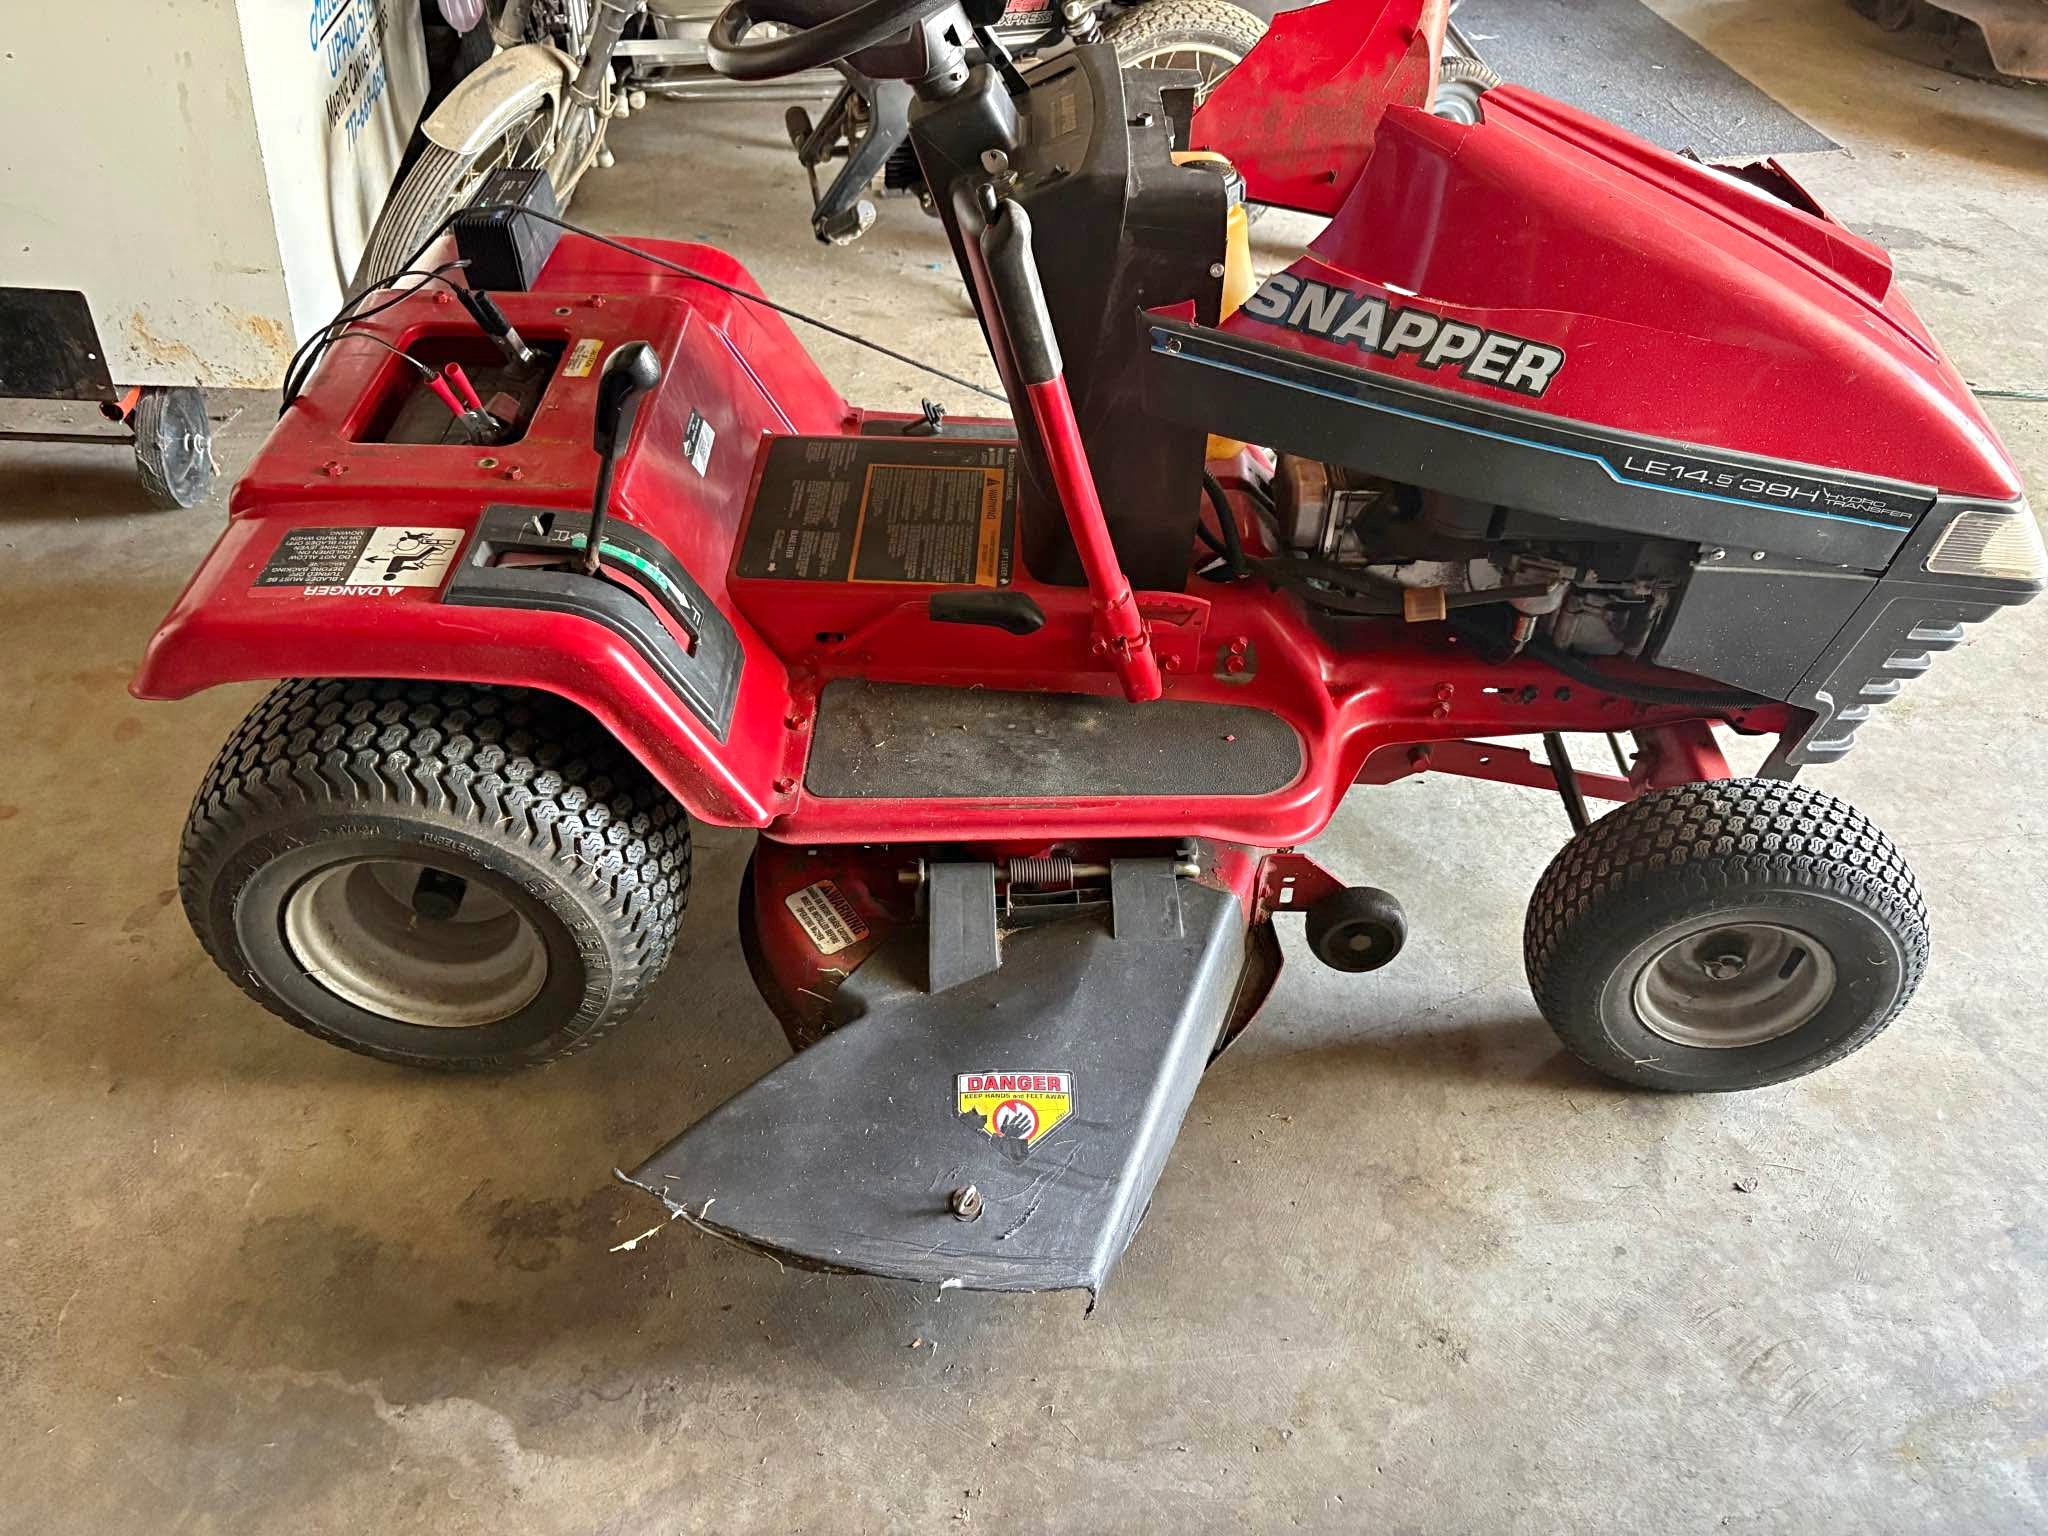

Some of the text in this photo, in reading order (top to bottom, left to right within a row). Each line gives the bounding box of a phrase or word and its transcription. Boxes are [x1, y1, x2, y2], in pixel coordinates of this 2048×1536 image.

[1243, 273, 1563, 394] SNAPPER
[1624, 456, 1819, 503] LE14.5 38H
[986, 489, 999, 520] WARNING
[1824, 498, 1913, 520] TRANSFER
[1826, 493, 1886, 508] HYDRO
[304, 586, 384, 597] DANGER
[827, 915, 842, 929] GRASS
[828, 891, 866, 934] WARNING
[824, 928, 841, 944] BEFORE
[967, 1076, 1061, 1091] DANGER
